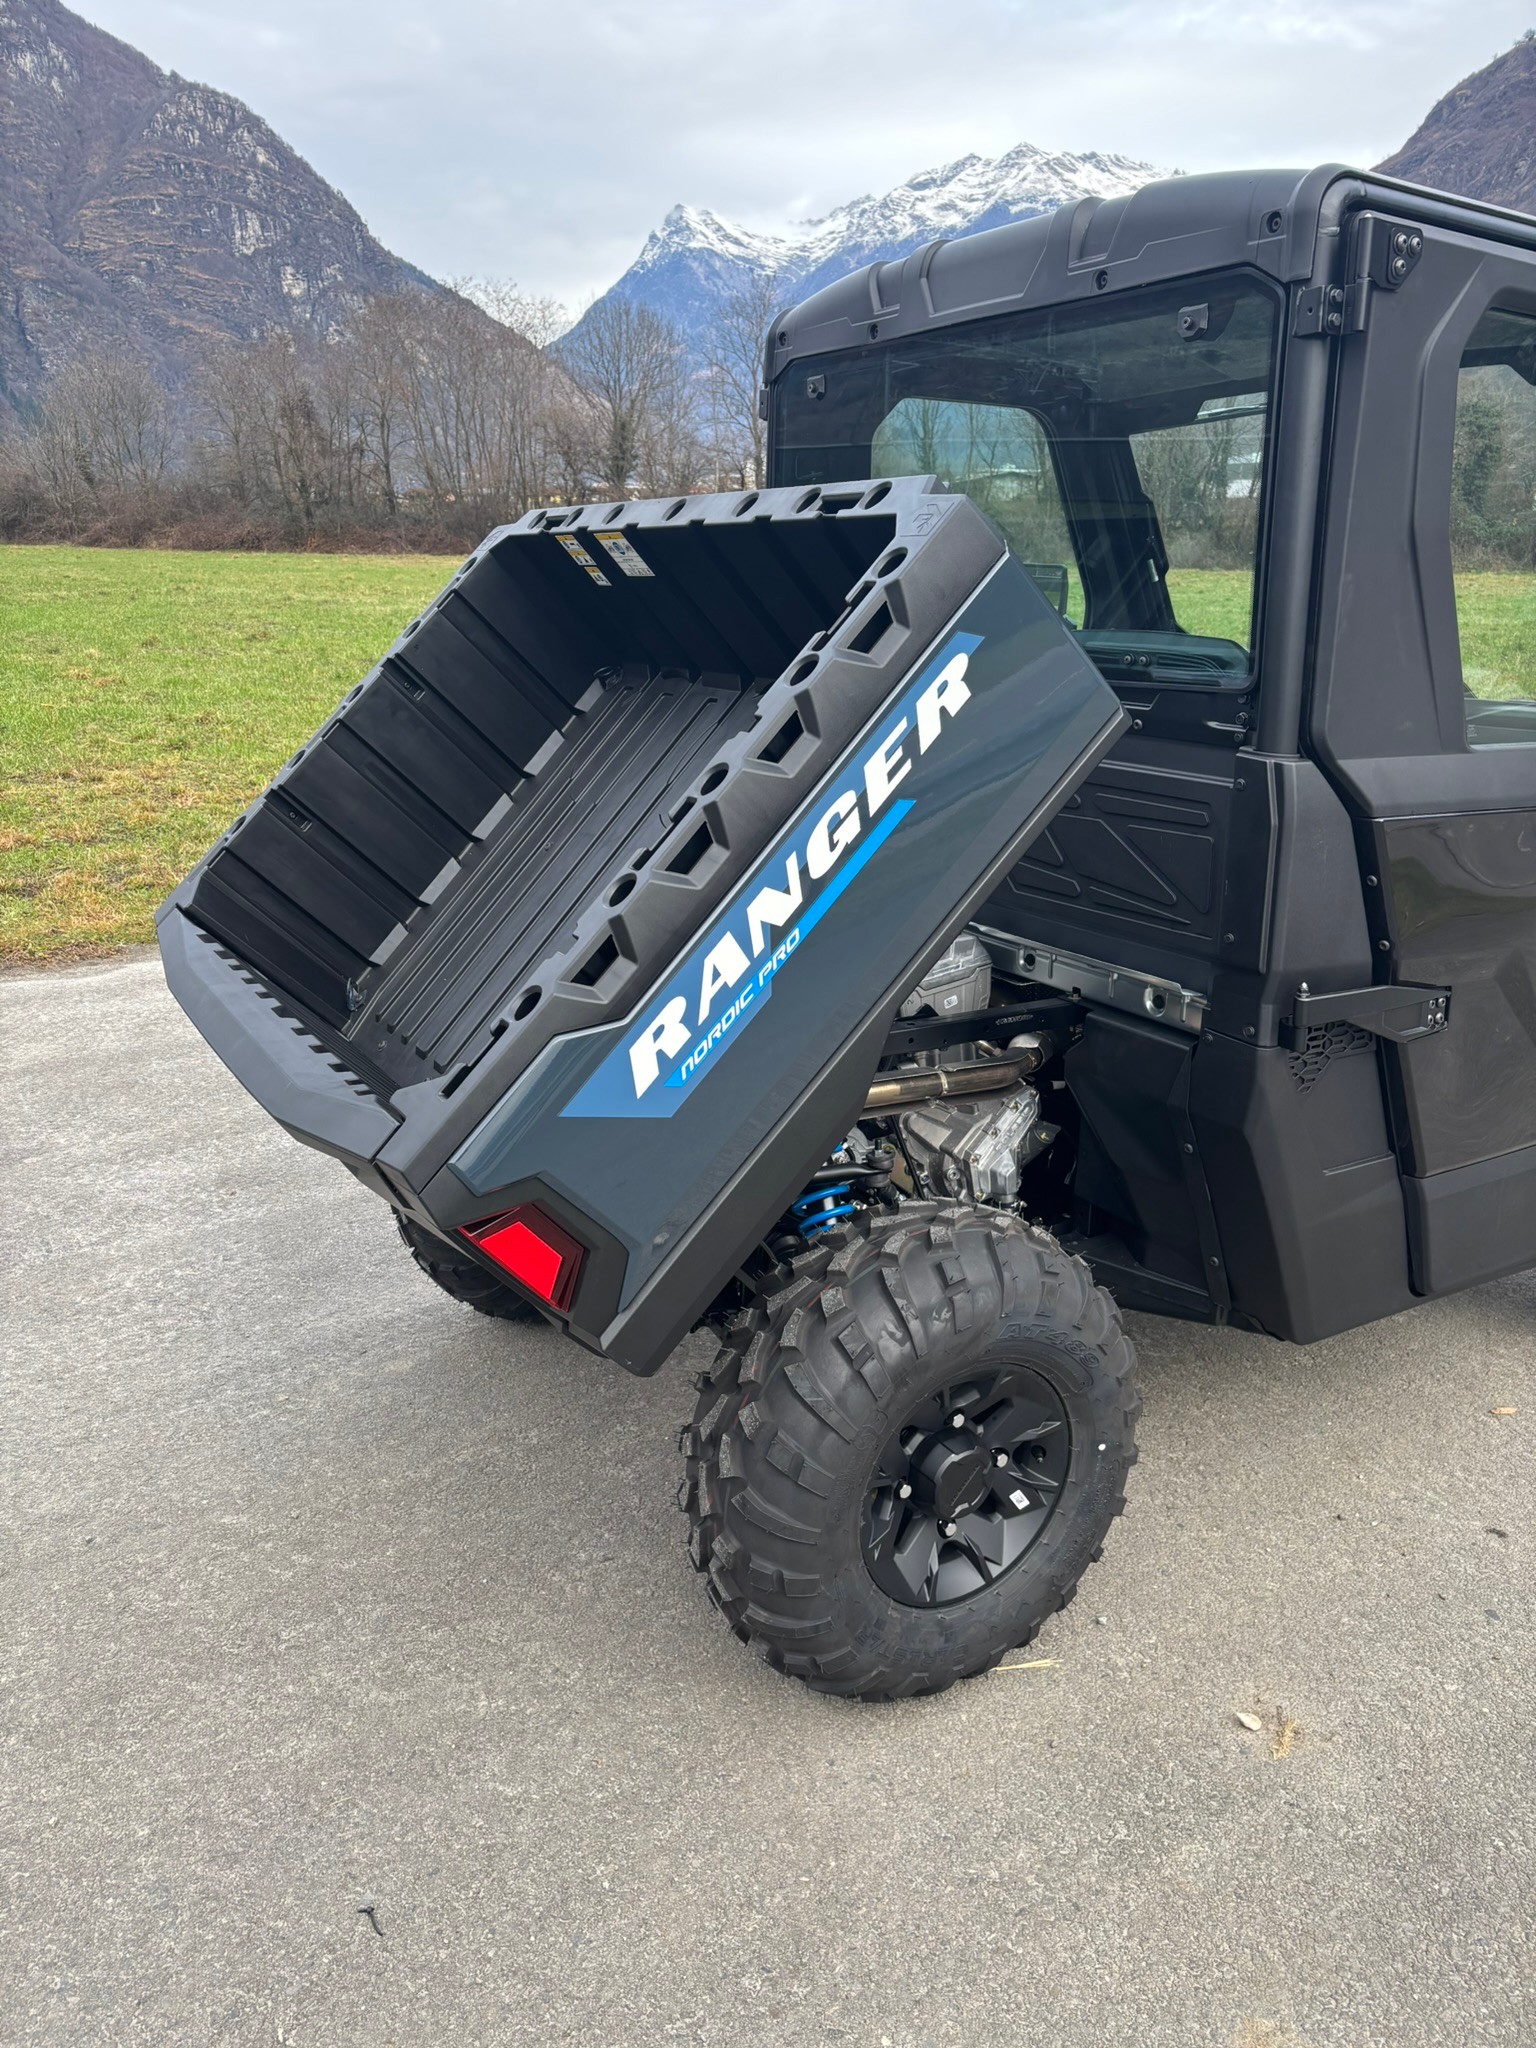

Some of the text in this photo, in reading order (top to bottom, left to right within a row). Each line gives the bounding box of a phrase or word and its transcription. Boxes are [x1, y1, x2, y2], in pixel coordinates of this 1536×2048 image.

[630, 653, 972, 1099] RANGER
[681, 928, 800, 1081] NORDIC PRO
[998, 1322, 1099, 1368] AT489
